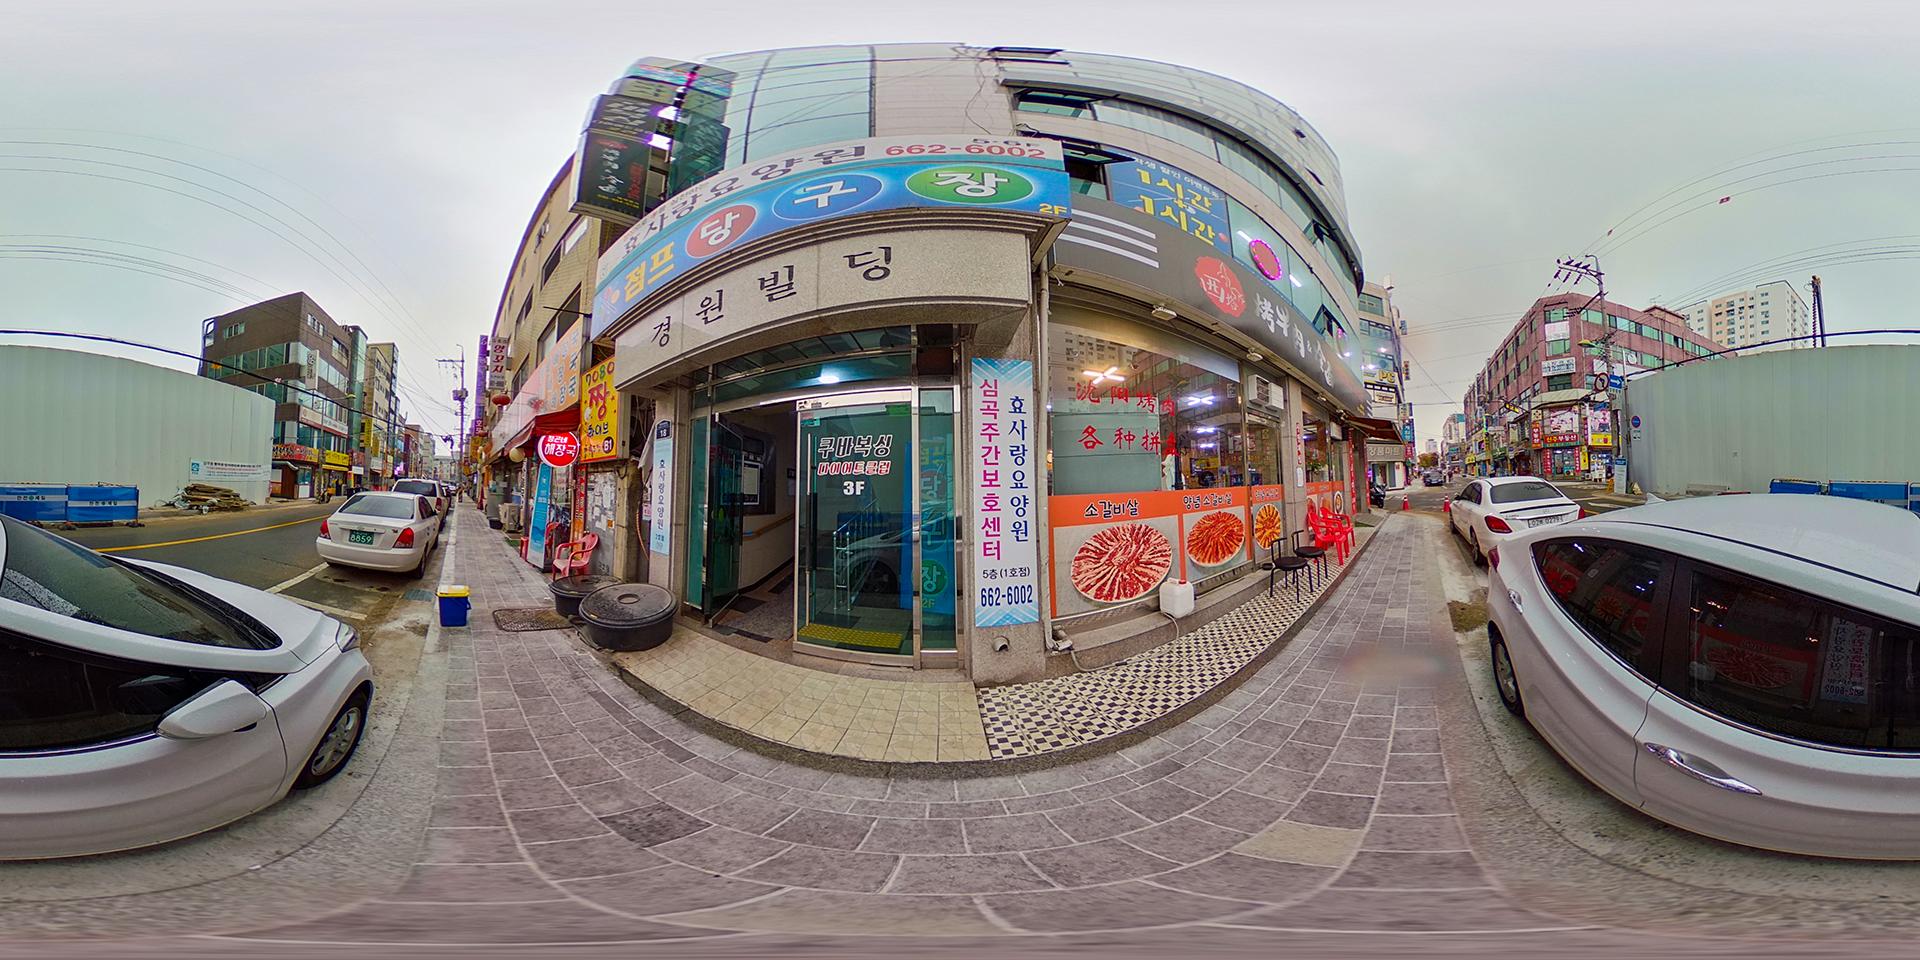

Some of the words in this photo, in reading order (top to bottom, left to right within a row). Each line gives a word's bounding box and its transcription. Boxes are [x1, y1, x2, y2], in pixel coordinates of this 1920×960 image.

[885, 143, 1046, 160] 662-6002
[1136, 168, 1213, 215] 1시간
[1040, 203, 1067, 216] 2F
[1140, 195, 1216, 246] 1시간
[624, 241, 675, 302] 점프
[651, 246, 893, 348] 경원빌딩
[585, 361, 615, 386] 7080
[544, 443, 577, 457] 해장국
[817, 434, 893, 459] 쿠바복싱
[817, 460, 892, 477] 다이어트클럽
[979, 379, 1002, 561] 심곡주간보호센터
[1008, 396, 1029, 542] 효사랑요양원
[843, 480, 865, 496] 3F
[1084, 499, 1139, 519] 소갈비살
[1183, 494, 1200, 510] 양념
[1203, 491, 1232, 506] 소갈비살
[350, 533, 372, 543] 8859
[980, 584, 1033, 608] 662-6002
